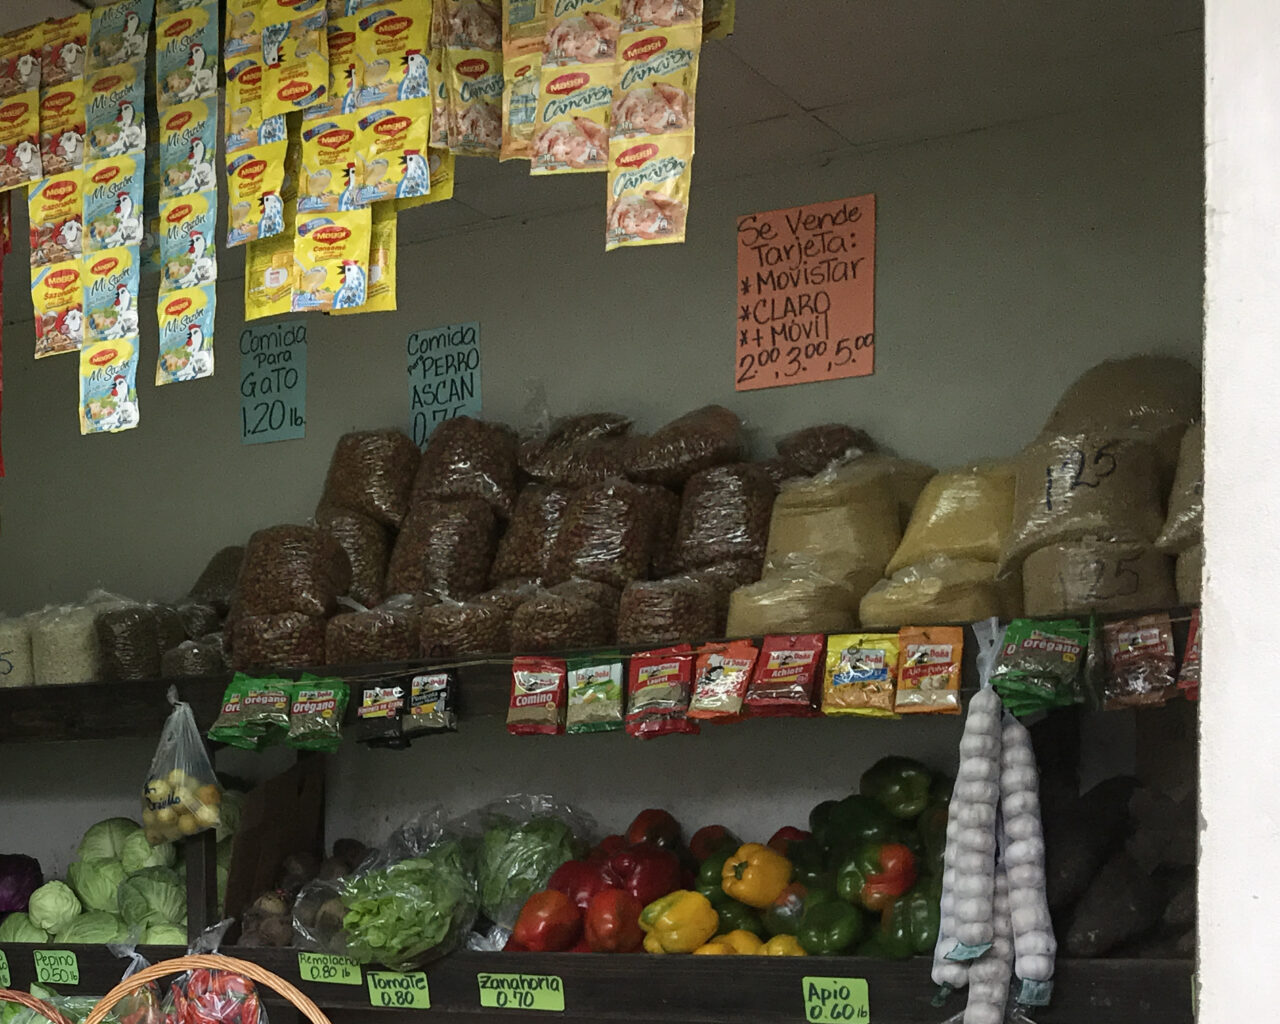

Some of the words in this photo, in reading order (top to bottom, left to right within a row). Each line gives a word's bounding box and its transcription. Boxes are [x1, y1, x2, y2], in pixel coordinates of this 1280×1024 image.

[738, 216, 777, 246] Se
[786, 204, 862, 236] Vende
[753, 291, 830, 324] CLARO
[240, 325, 307, 355] Comida
[408, 326, 476, 356] Comida
[422, 348, 480, 378] PERRO
[412, 373, 474, 410] ASCAN
[243, 400, 286, 438] 1.20
[1024, 640, 1080, 654] Orégano
[770, 668, 804, 678] Achiote
[292, 701, 335, 714] Orégano
[516, 693, 553, 706] Comino
[34, 951, 74, 970] Pepino
[310, 966, 338, 980] 0.80
[342, 968, 350, 978] lb
[381, 991, 414, 1006] 0.80
[496, 991, 534, 1008] 0.70
[810, 1003, 855, 1020] 0.60
[857, 1005, 868, 1018] lb
